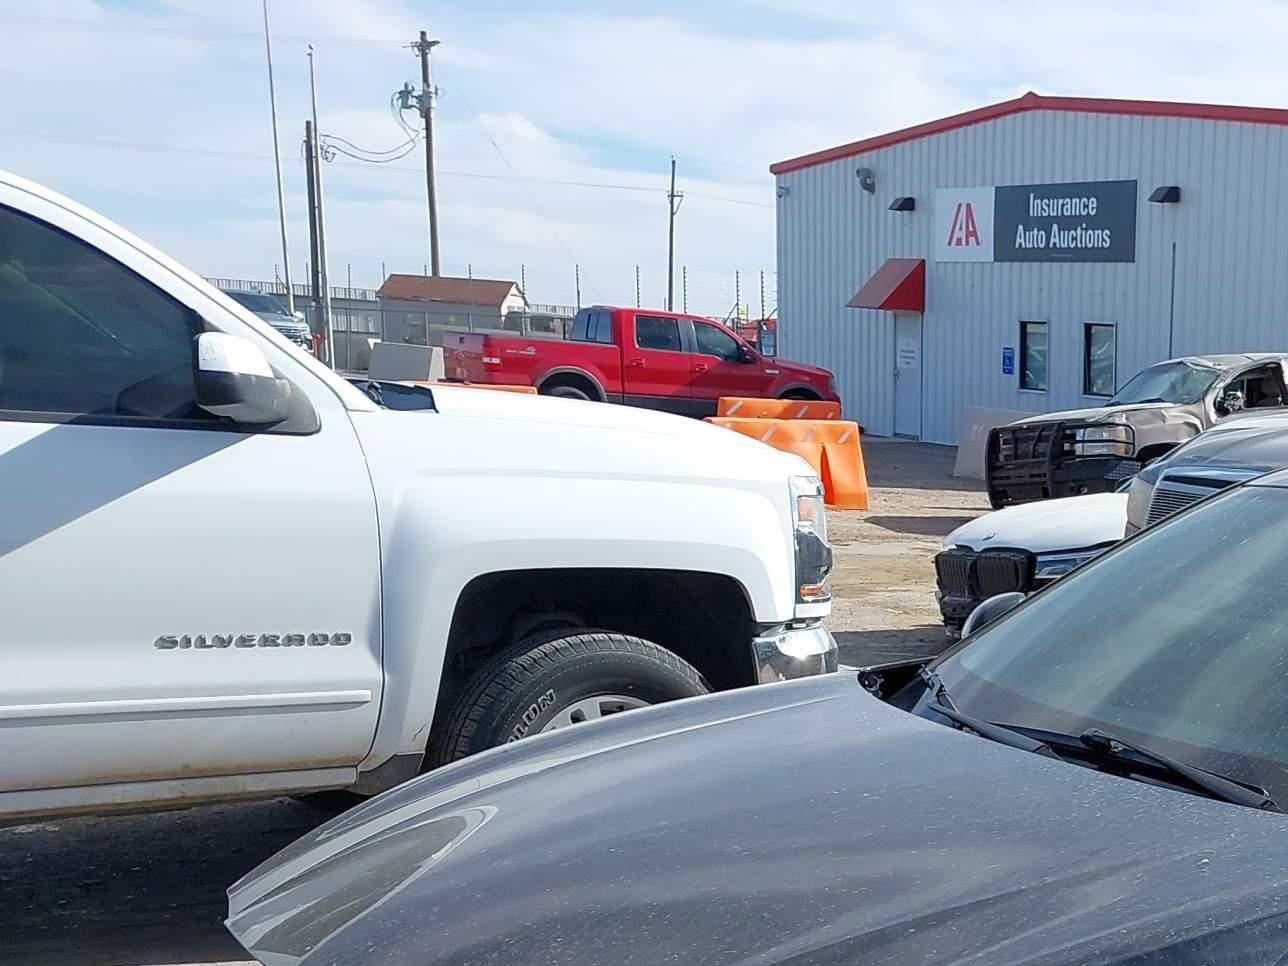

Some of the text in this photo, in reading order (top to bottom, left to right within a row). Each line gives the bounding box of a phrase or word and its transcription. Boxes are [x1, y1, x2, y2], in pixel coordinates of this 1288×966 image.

[1029, 192, 1097, 217] Insurance
[1015, 222, 1111, 249] Auto Auctions
[153, 632, 353, 650] SILVERADO
